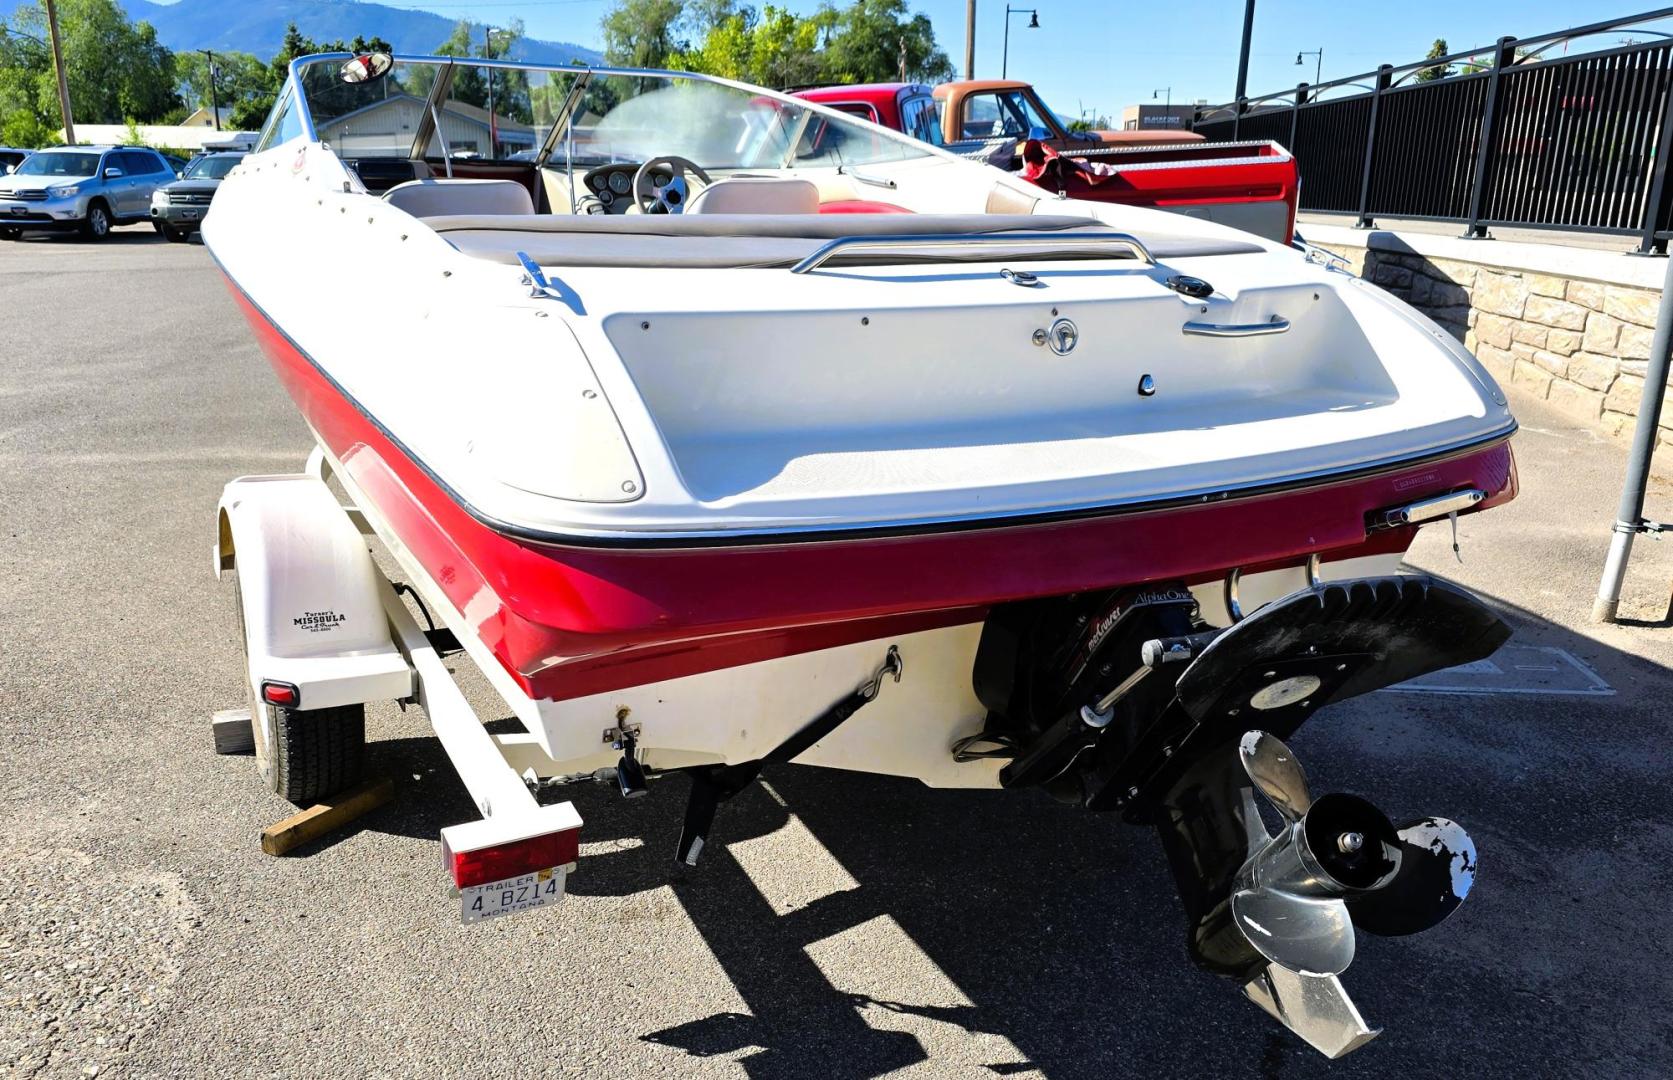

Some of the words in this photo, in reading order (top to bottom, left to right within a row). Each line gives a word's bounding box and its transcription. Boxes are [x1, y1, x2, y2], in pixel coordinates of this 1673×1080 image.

[293, 614, 346, 625] MISSOULA
[478, 876, 534, 893] TRAILER
[481, 899, 545, 918] MONTANA
